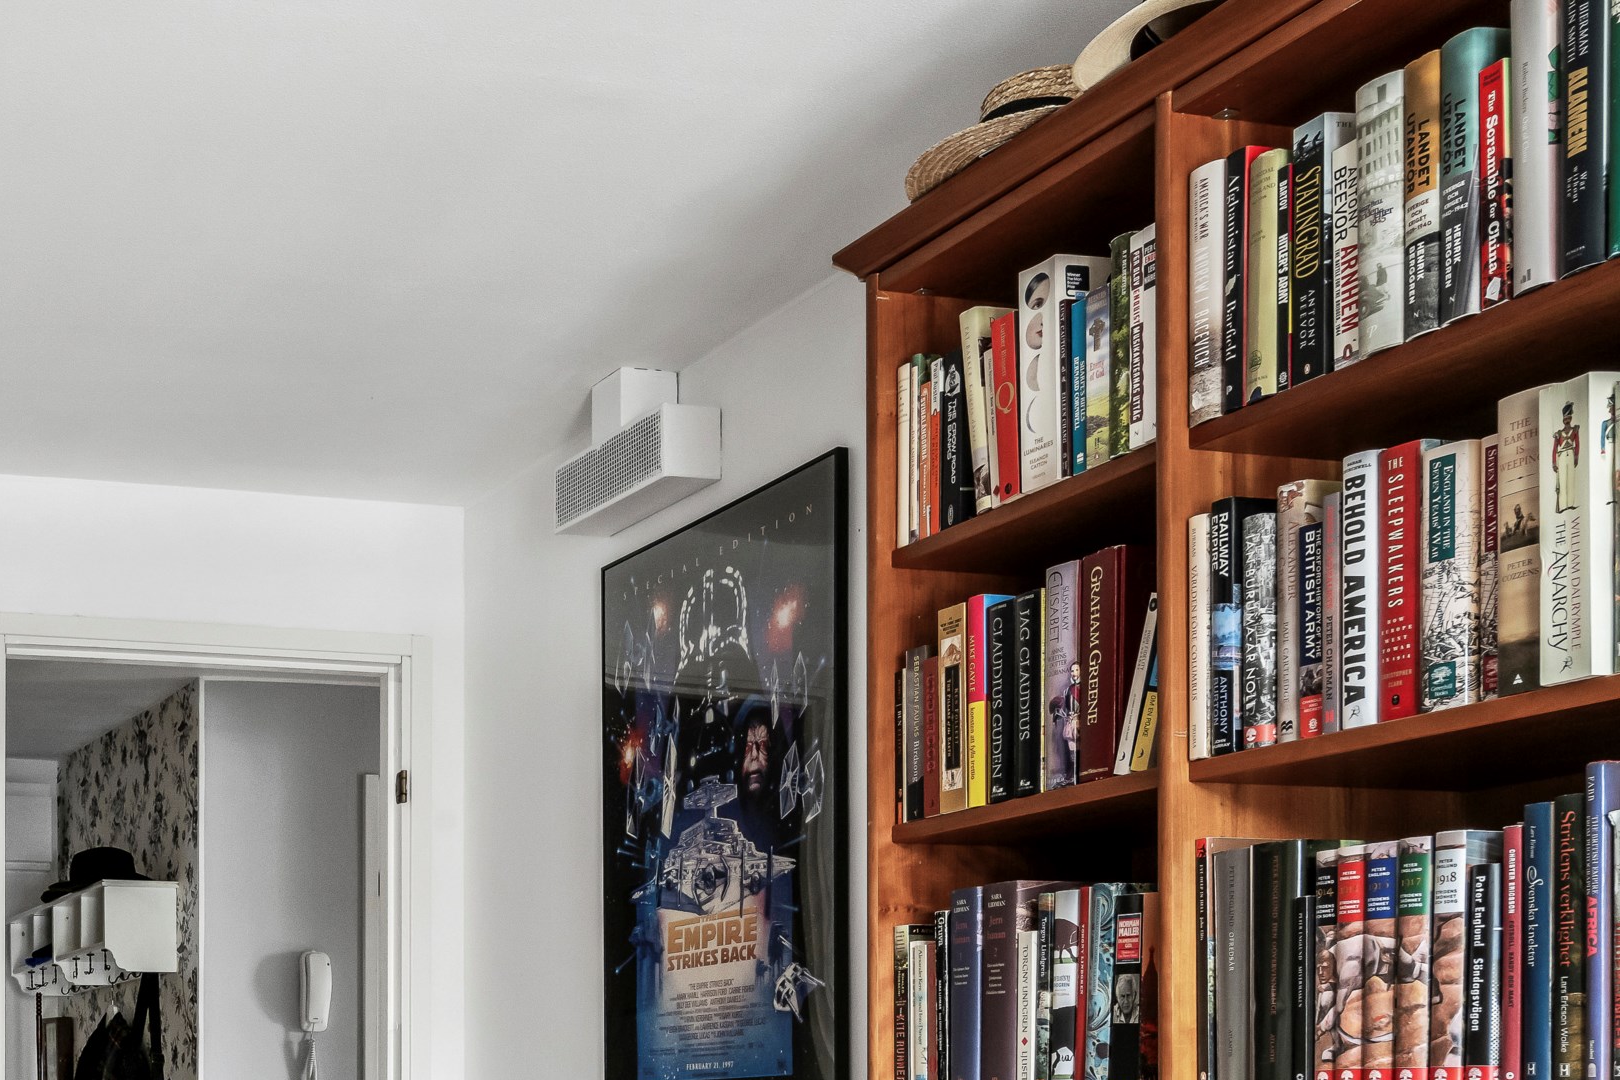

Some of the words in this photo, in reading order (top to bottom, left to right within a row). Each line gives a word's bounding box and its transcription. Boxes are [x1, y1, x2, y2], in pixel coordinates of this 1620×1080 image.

[1453, 98, 1467, 169] LANDET
[1567, 66, 1588, 159] ALAMEIN
[1416, 118, 1430, 187] LANDET
[1295, 165, 1322, 279] STALINGRAD
[1334, 166, 1348, 244] BEEVOR
[1407, 244, 1415, 305] BERGGREN
[1416, 240, 1425, 281] HENRIK
[1444, 227, 1453, 289] BERGGREN
[1453, 223, 1462, 264] HENRIK
[1487, 219, 1500, 275] China
[1307, 289, 1315, 346] ANTONY
[1340, 243, 1359, 333] ARNHEM
[1211, 515, 1219, 572] EMPIRE
[1218, 511, 1229, 577] RAILWAY
[1344, 474, 1366, 566] BEHOLD
[1388, 474, 1404, 608] SLEEPWALKERS
[1305, 530, 1316, 604] BRITISH
[1019, 609, 1030, 642] JAG
[1090, 565, 1103, 647] GRAHAM
[1305, 610, 1316, 659] ARMY
[992, 617, 1003, 708] CLAUDIUS
[1344, 575, 1366, 706] AMERICA
[1019, 648, 1030, 741] CLAUDIUS
[1087, 649, 1102, 725] GREENE
[992, 714, 1003, 779] GUDEN
[667, 910, 758, 954] EMPIRE
[1118, 919, 1140, 929] NORMAN
[1118, 927, 1140, 937] MAILER
[1586, 896, 1598, 958] AFRICA
[667, 950, 718, 972] STRIKES
[721, 943, 757, 964] BACK
[686, 1062, 712, 1071] FEBRUARY
[722, 1061, 734, 1069] 1997
